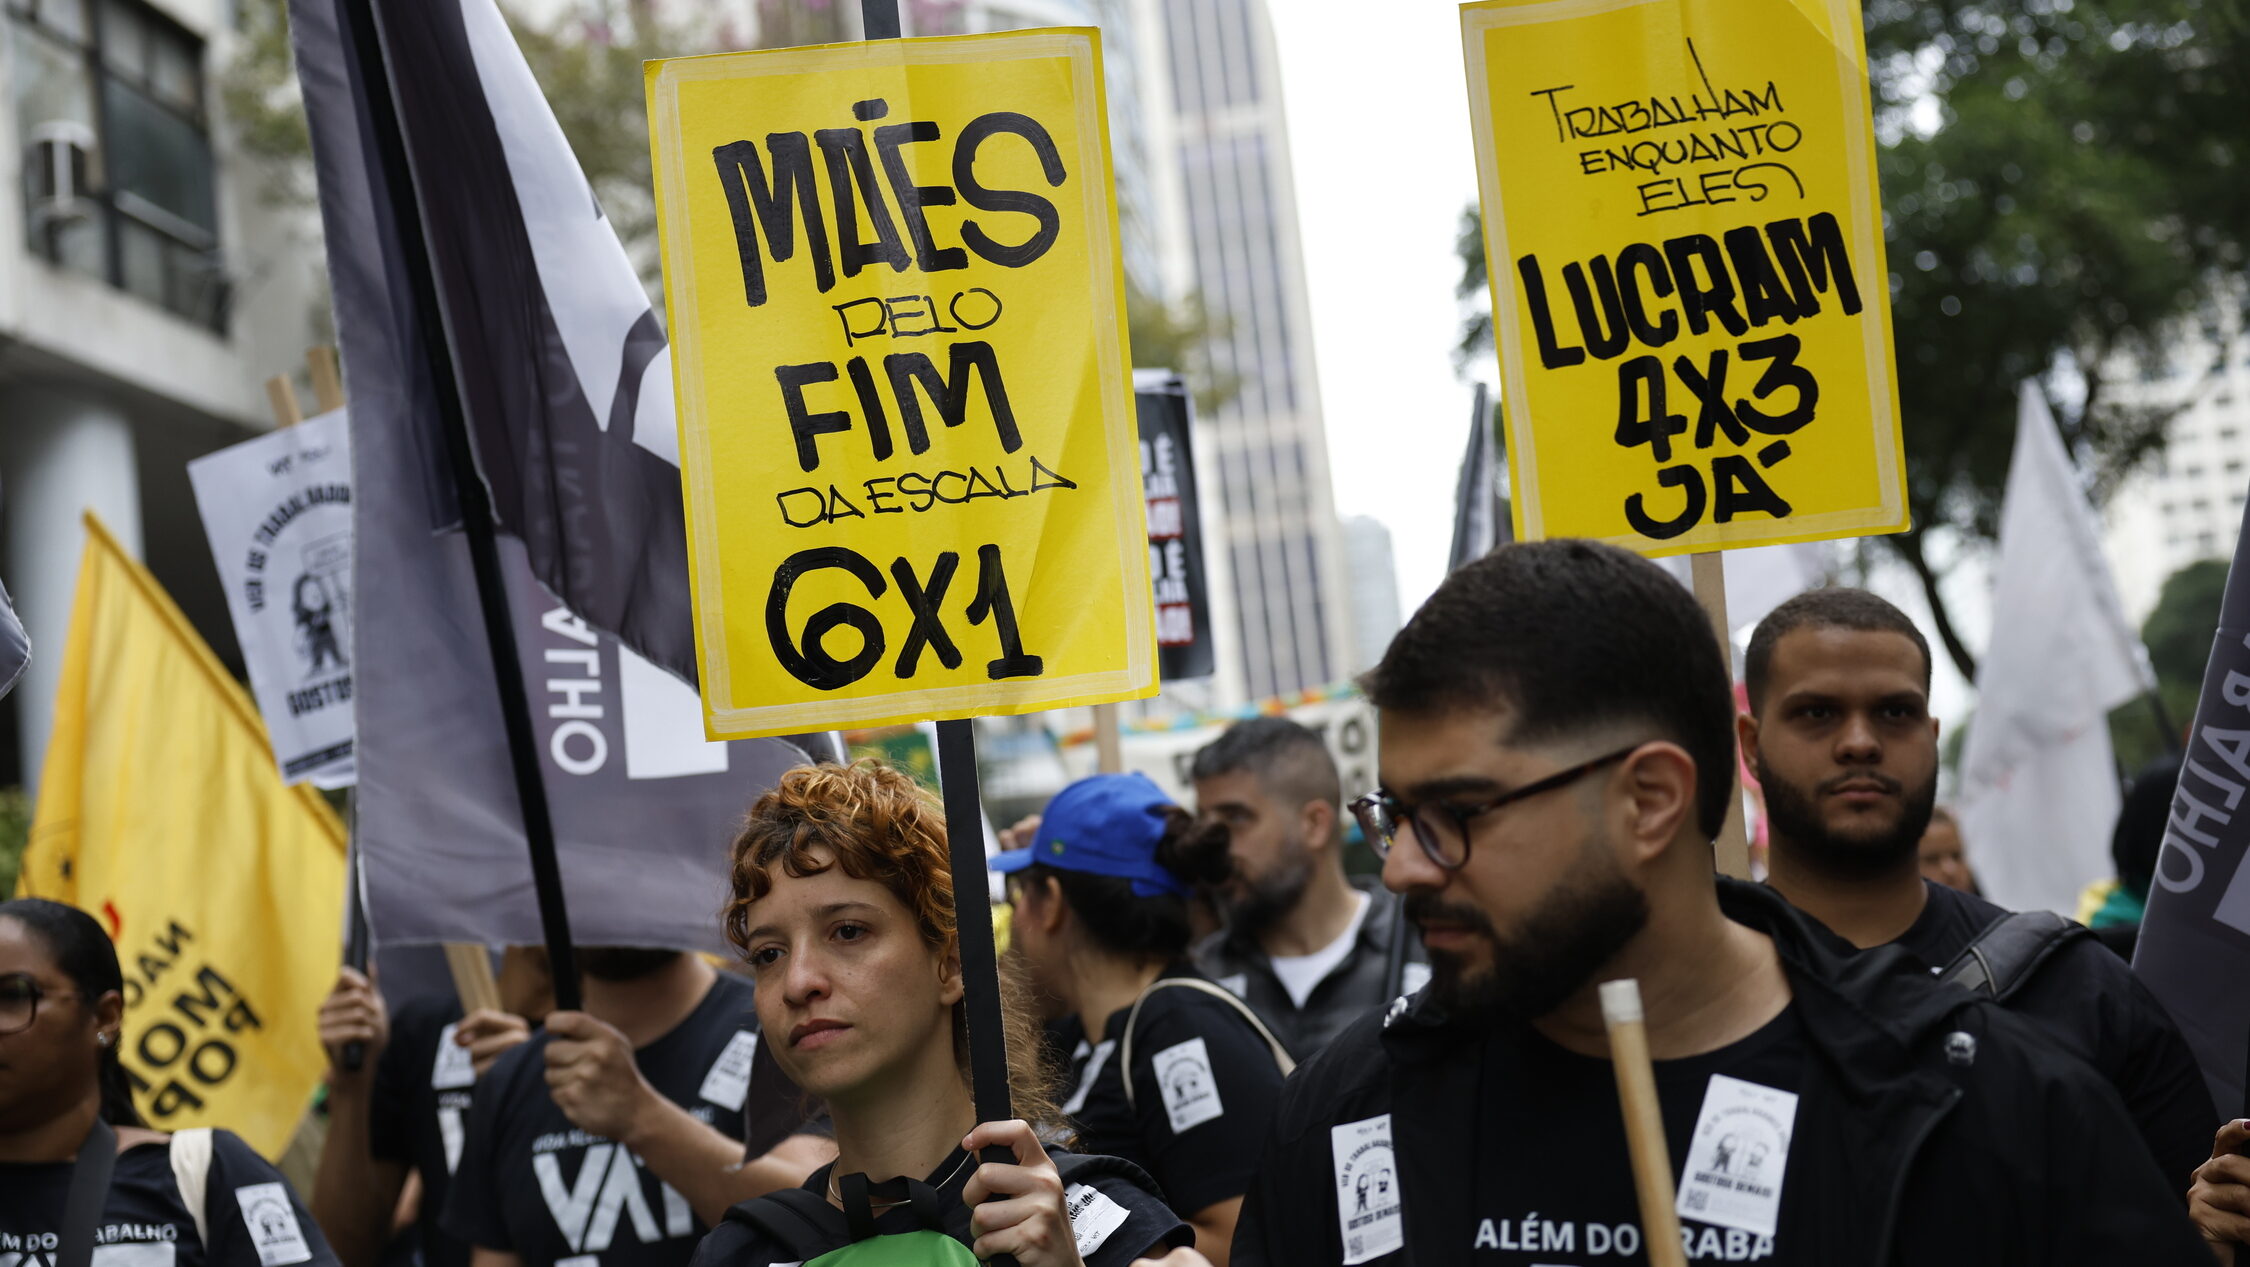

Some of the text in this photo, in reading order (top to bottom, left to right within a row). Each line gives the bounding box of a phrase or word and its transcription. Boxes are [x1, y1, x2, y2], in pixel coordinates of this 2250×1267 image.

[1530, 37, 1784, 143] TRABALHAM
[1580, 121, 1803, 176] ENQUANTO
[1636, 163, 1805, 217] ELES
[712, 98, 1067, 307] MÃES
[832, 287, 1003, 348] PELO
[1517, 211, 1863, 371] LUCRAM
[774, 340, 1023, 473] FIM
[1614, 333, 1820, 463] 4X3
[776, 455, 1077, 529] DA ESCALA
[1624, 439, 1793, 540] JÁ
[765, 543, 1044, 691] 6X1
[26, 1232, 59, 1252] DO
[1475, 1212, 1776, 1263] ALÉM DO RABA
